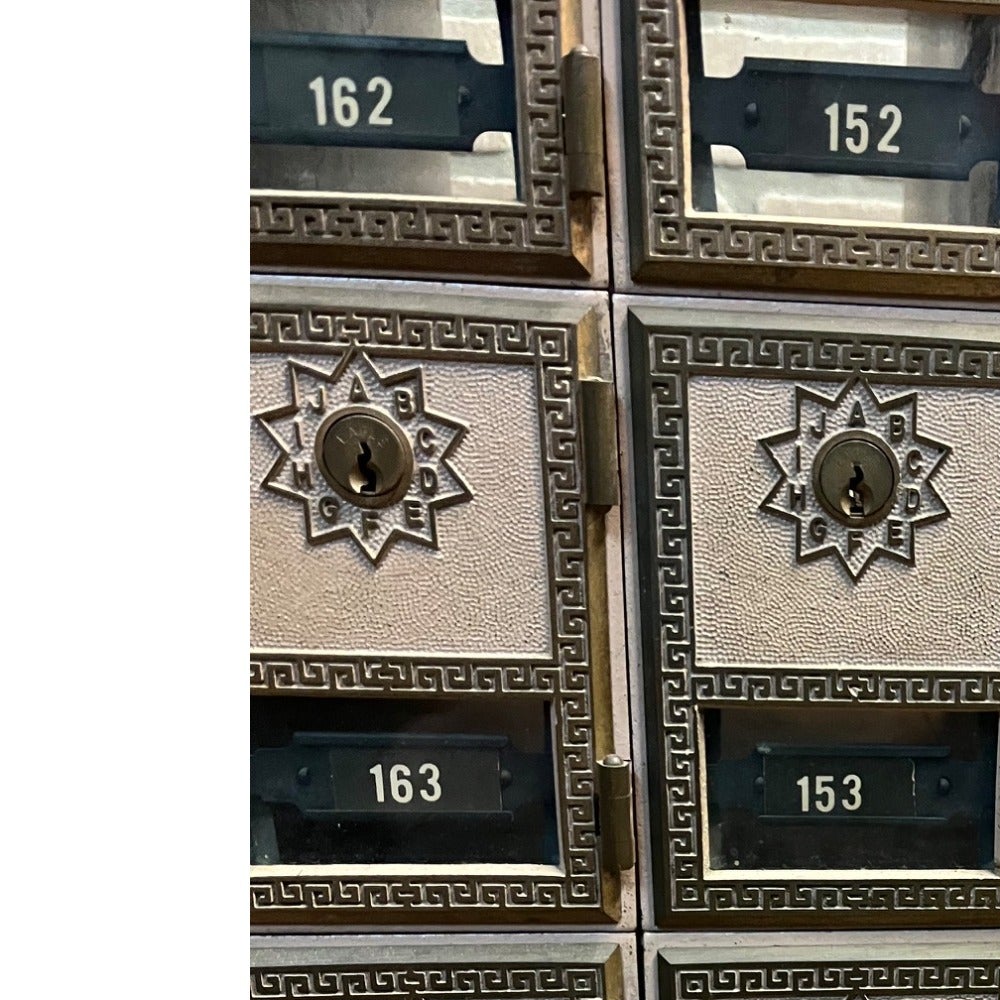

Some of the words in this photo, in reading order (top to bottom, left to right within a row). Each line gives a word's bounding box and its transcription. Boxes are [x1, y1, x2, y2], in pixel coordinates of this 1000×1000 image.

[308, 76, 393, 128] 162
[824, 102, 903, 154] 152
[351, 373, 369, 402] A
[395, 388, 415, 419] B
[417, 427, 435, 454] C
[420, 466, 437, 495] D
[369, 763, 442, 804] 163
[796, 774, 862, 813] 153
